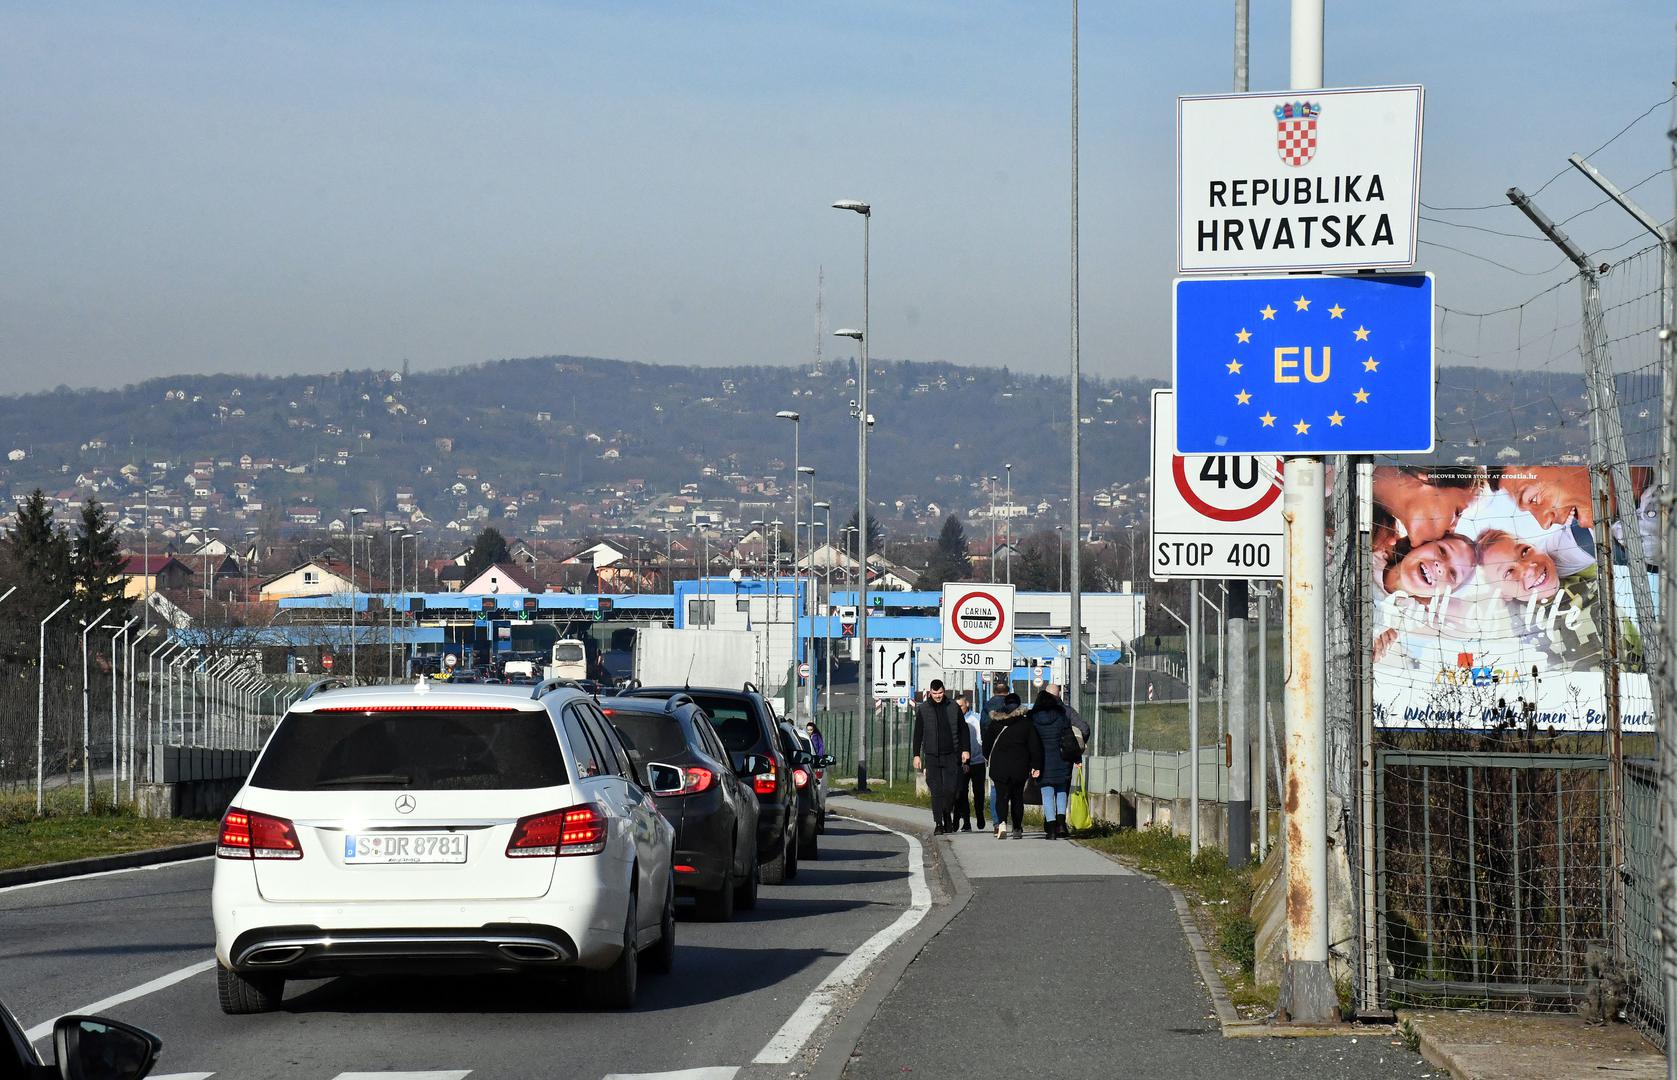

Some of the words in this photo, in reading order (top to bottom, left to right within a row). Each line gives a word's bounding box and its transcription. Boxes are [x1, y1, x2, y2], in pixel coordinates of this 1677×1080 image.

[1209, 174, 1385, 208] REPUBLIKA
[1197, 213, 1395, 252] HRVATSKA
[1274, 346, 1331, 384] EU
[1199, 455, 1260, 490] 40
[1501, 472, 1538, 480] croatia.hr
[1157, 542, 1214, 567] STOP
[1226, 543, 1271, 568] 400
[965, 607, 992, 616] CARINA
[1524, 588, 1582, 643] life
[963, 620, 993, 629] DOUANE
[960, 653, 980, 665] 350
[985, 656, 994, 665] m
[1404, 704, 1463, 722] Welcome
[384, 837, 409, 856] DR
[413, 836, 463, 856] 8781
